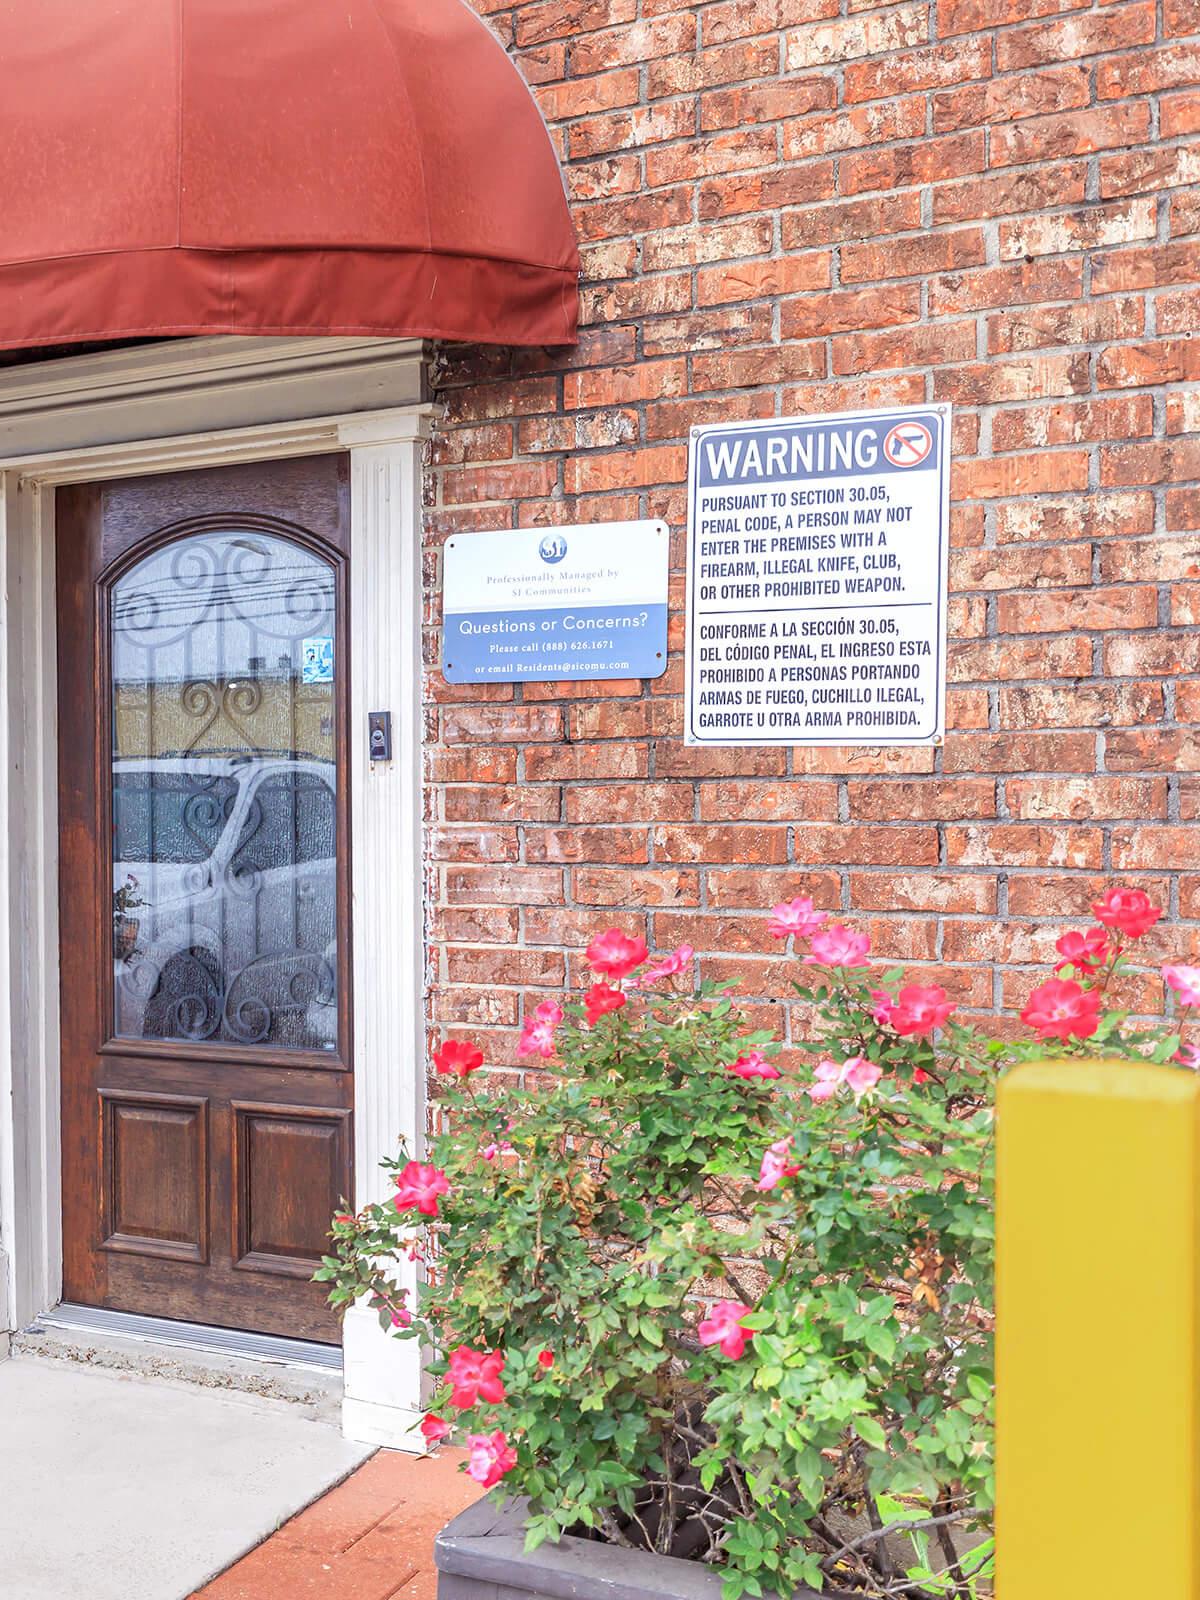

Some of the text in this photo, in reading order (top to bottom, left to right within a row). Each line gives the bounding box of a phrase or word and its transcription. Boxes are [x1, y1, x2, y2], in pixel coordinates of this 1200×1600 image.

[705, 429, 878, 479] WARNING
[701, 484, 890, 512] PURSUANT TO SECTION 30.05,
[701, 506, 912, 534] PENAL CODE, A PERSON MAY NOT
[701, 531, 887, 556] ENTER THE PREMISES WITH A
[487, 568, 618, 584] Professionally Managed by
[700, 553, 901, 580] FIREARM, ILLEGAL KNIFE, CLUB,
[525, 586, 591, 595] Communities
[699, 576, 905, 600] OR OTHER PROHIBITED WEAPON.
[459, 612, 648, 634] Questions or Concerns?
[700, 616, 899, 639] CONFORME A LA SECCIÓN 30.05,
[489, 640, 613, 653] Please call (888) 626.1671
[699, 641, 931, 661] DEL CÓDIGO PENAL, EL INGRESO ESTA
[488, 664, 512, 673] email
[699, 664, 920, 683] PROHIBIDO A PERSONAS PORTANDO
[699, 687, 924, 706] ARMAS DE FUEGO, CUCHILLO ILEGAL,
[698, 711, 920, 727] GARROTE U OTRA ARMA PROHIBIDA.
